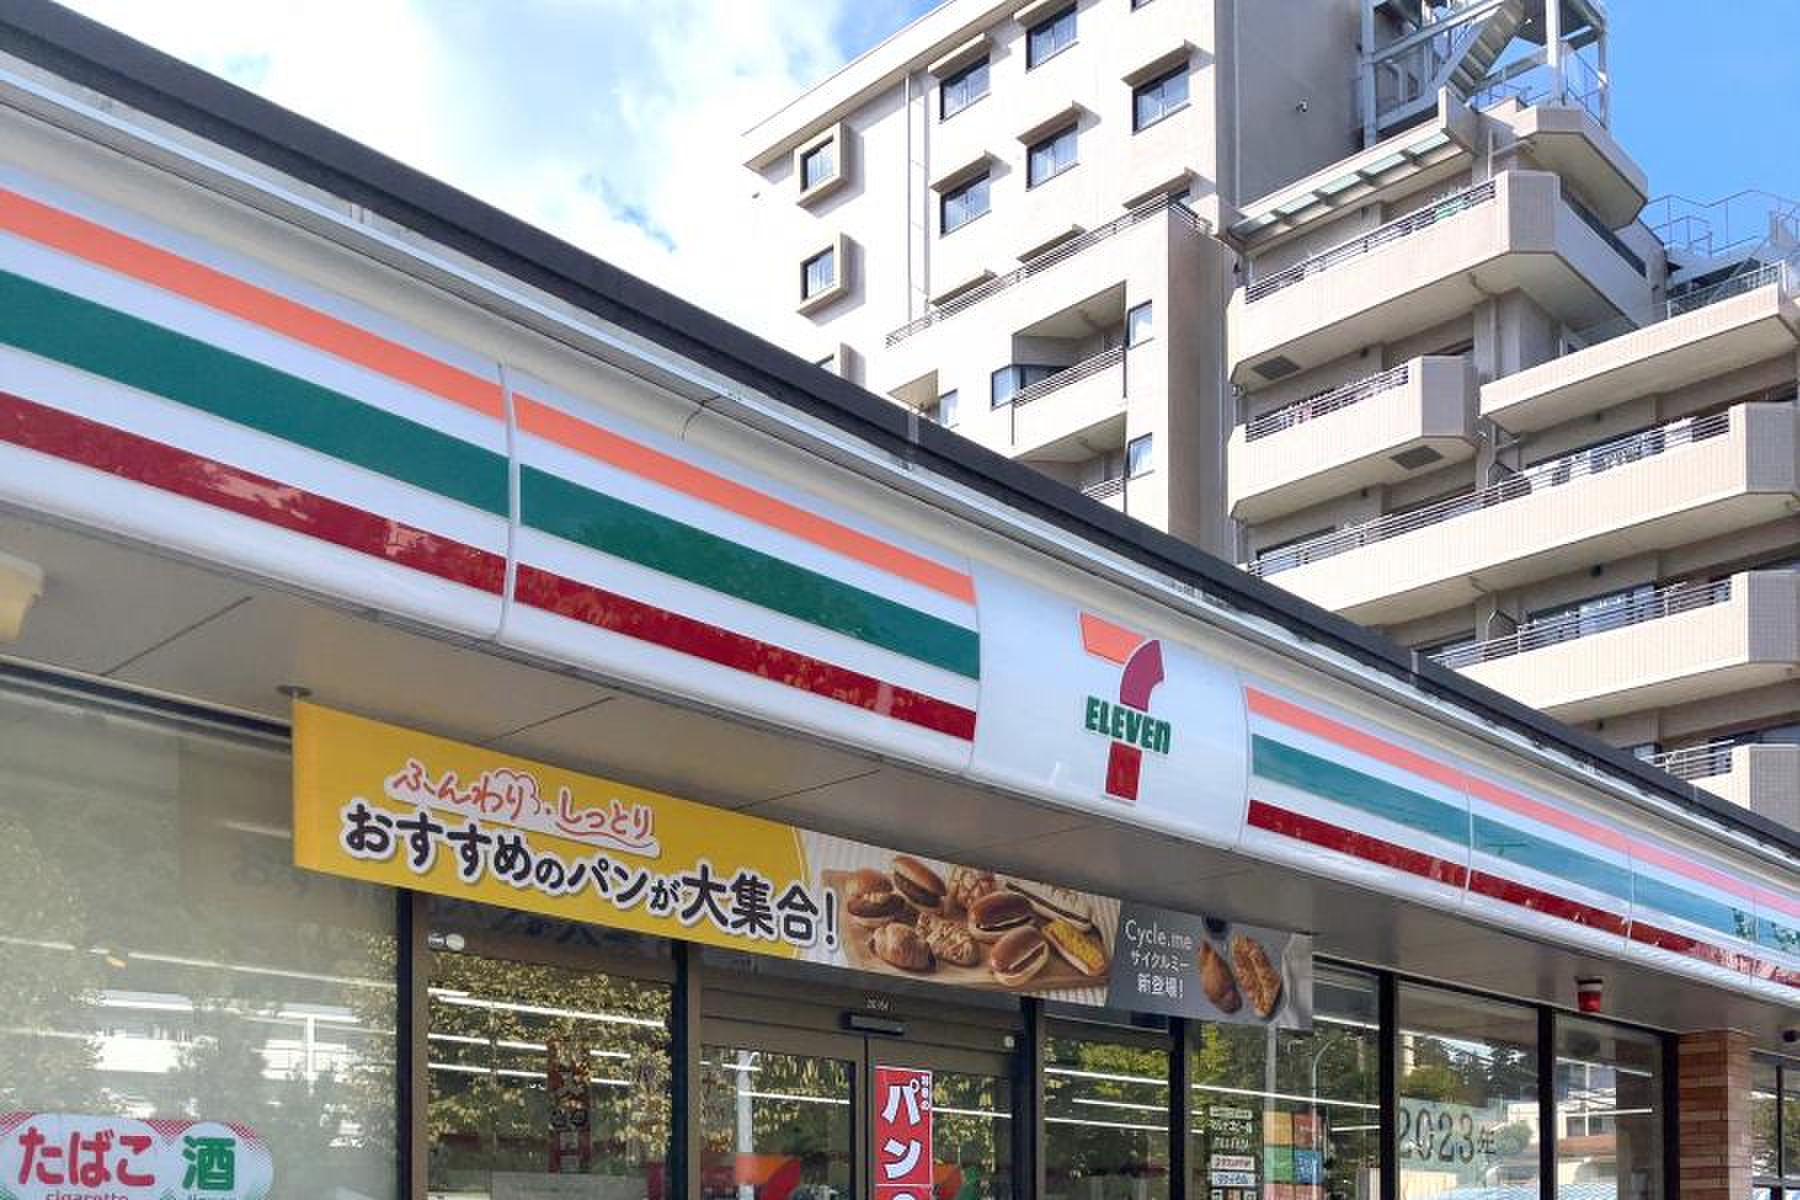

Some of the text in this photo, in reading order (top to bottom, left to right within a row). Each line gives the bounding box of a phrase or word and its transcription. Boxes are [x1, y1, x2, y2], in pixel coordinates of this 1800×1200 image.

[1085, 695, 1171, 755] ELEVEN
[18, 1125, 155, 1188] たばこ
[182, 1134, 237, 1191] 酒
